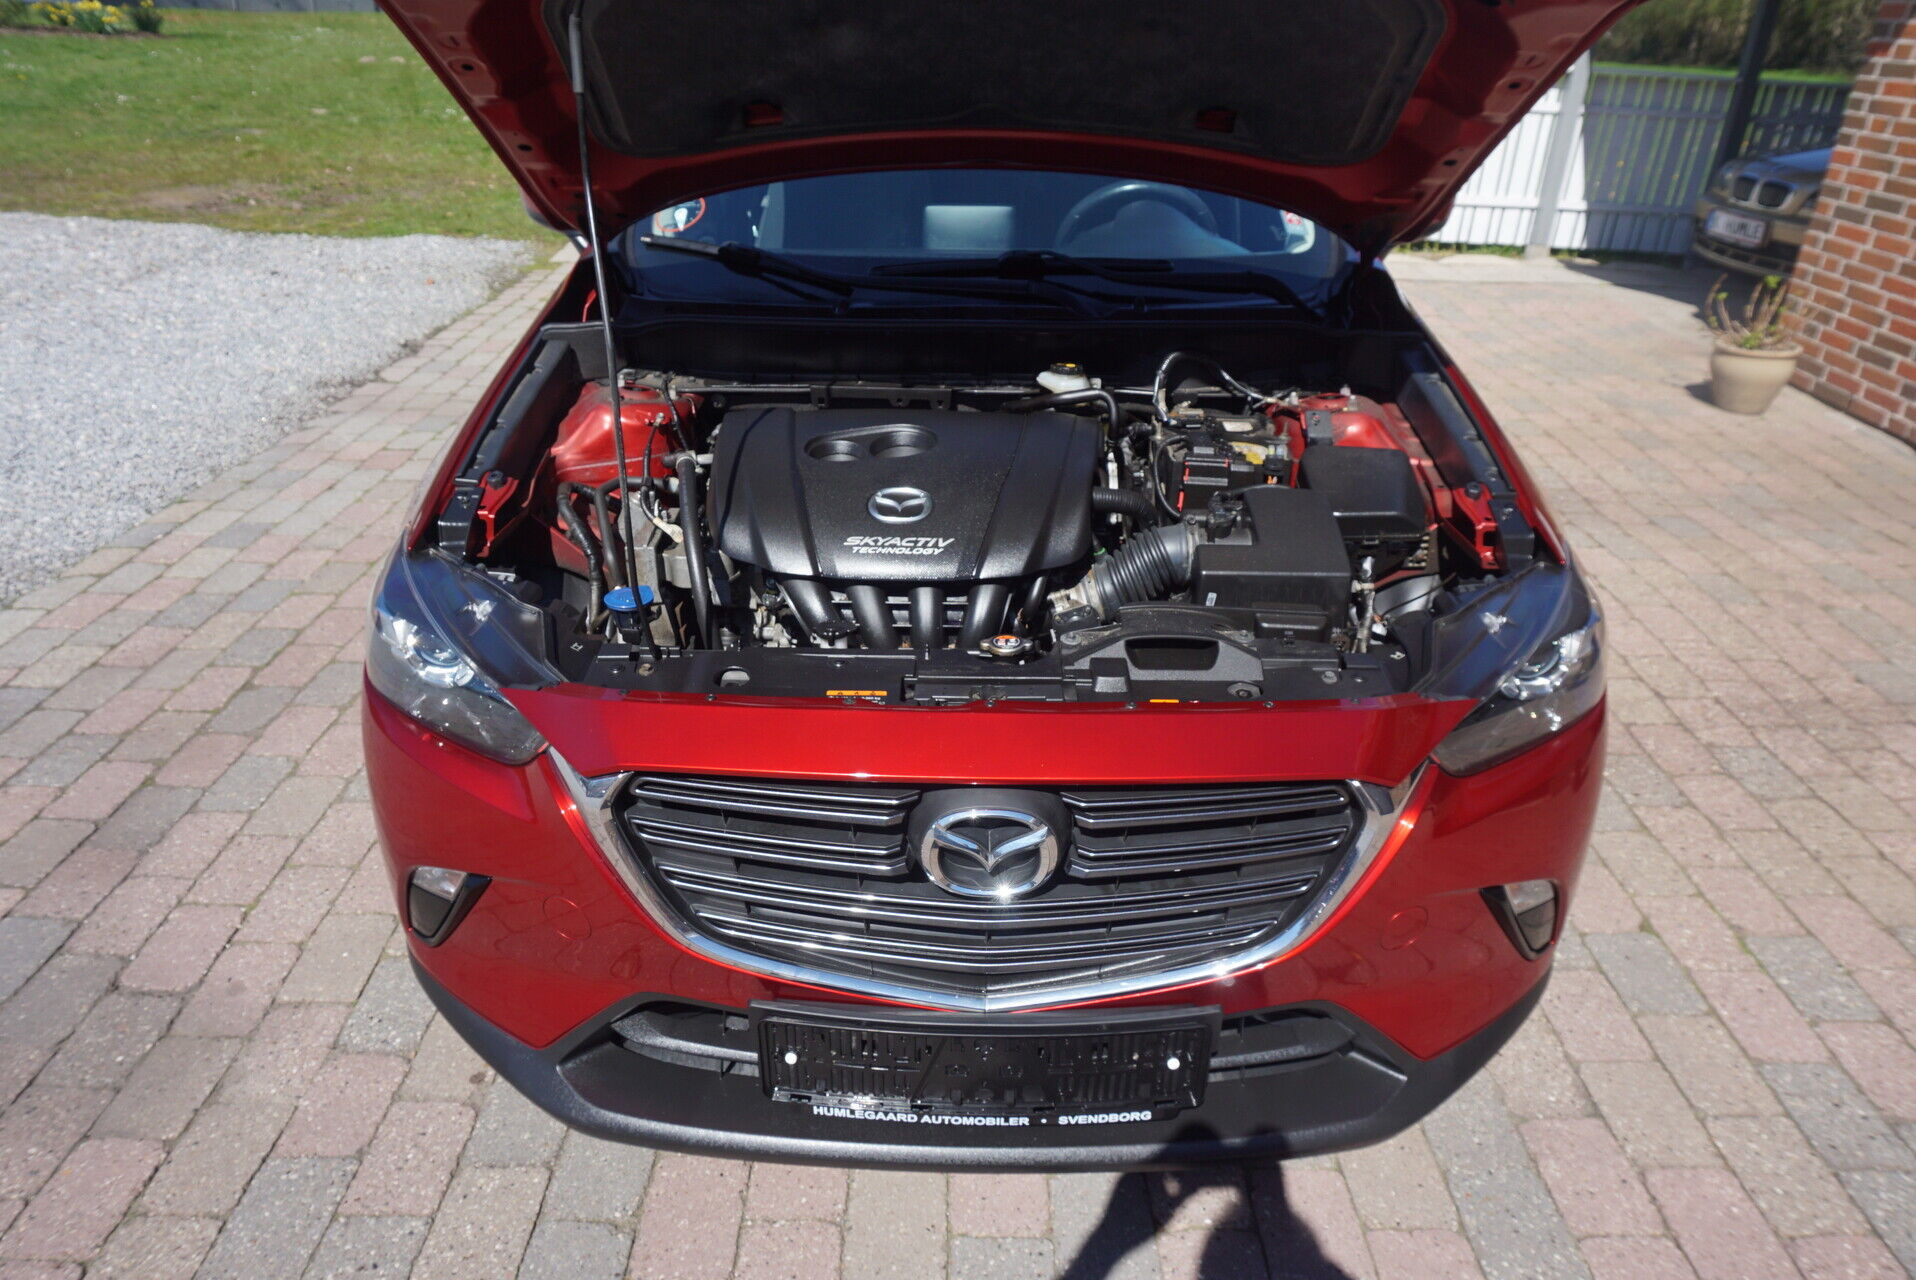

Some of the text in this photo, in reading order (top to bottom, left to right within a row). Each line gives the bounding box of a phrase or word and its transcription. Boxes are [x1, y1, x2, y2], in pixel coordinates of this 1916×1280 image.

[843, 536, 955, 547] SKYACTIV
[852, 547, 944, 555] TECHNOLOGY
[813, 1106, 1152, 1127] HUMLEGAARD AUTOMOBILER SVENDBORG
